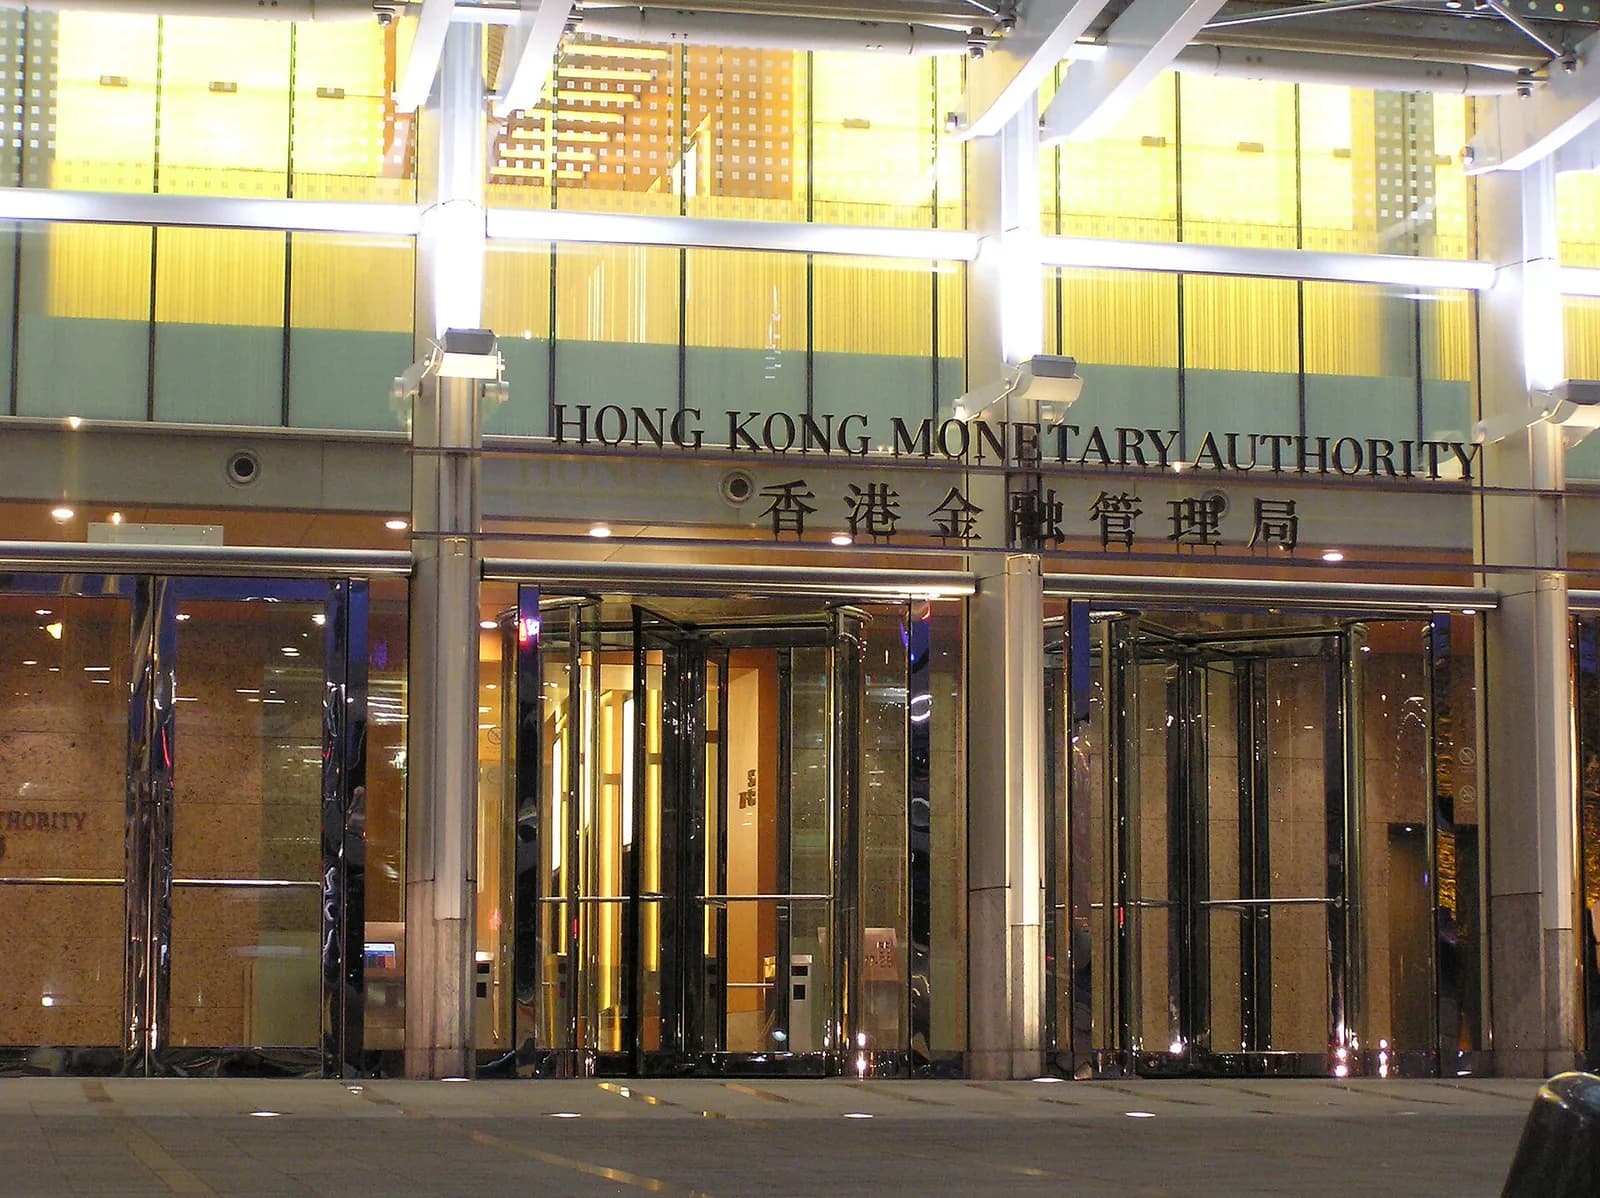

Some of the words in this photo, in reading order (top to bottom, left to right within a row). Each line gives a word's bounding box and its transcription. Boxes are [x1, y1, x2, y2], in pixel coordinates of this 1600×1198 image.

[552, 403, 704, 449] HONG
[725, 411, 870, 456] KONG
[890, 417, 1179, 465] MONETARY
[1194, 431, 1481, 480] AUTHORITY
[759, 480, 1300, 549] 香港金融管理局
